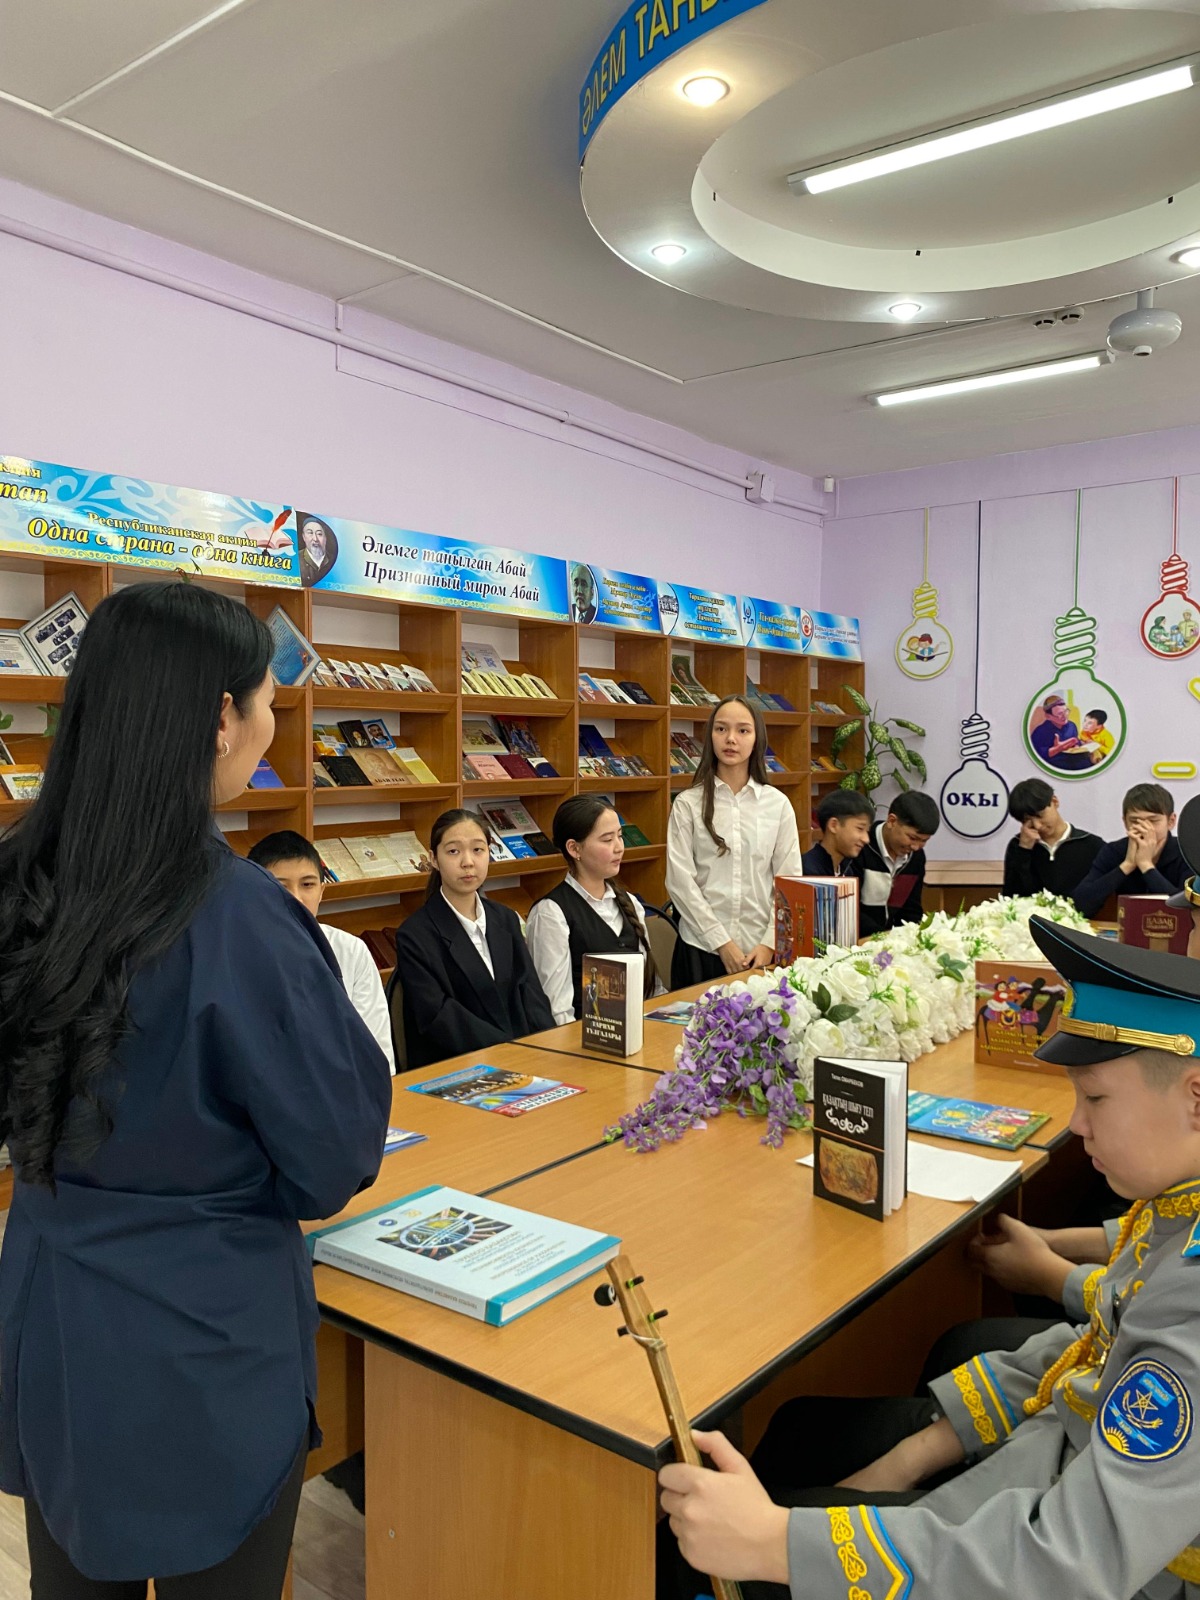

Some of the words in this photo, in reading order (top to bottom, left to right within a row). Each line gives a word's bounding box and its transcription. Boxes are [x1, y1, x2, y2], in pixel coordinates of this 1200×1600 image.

[27, 517, 90, 545] Одна
[95, 531, 175, 555] страна
[191, 541, 238, 563] одна
[241, 551, 292, 571] книга
[87, 511, 215, 542] Республиканская
[217, 534, 258, 548] акция
[362, 535, 419, 560] Әлемге
[495, 557, 527, 578] Абай
[363, 560, 461, 591] Признанный
[463, 580, 507, 598] миром
[509, 584, 540, 602] Абай
[946, 792, 999, 808] ОҚЫ
